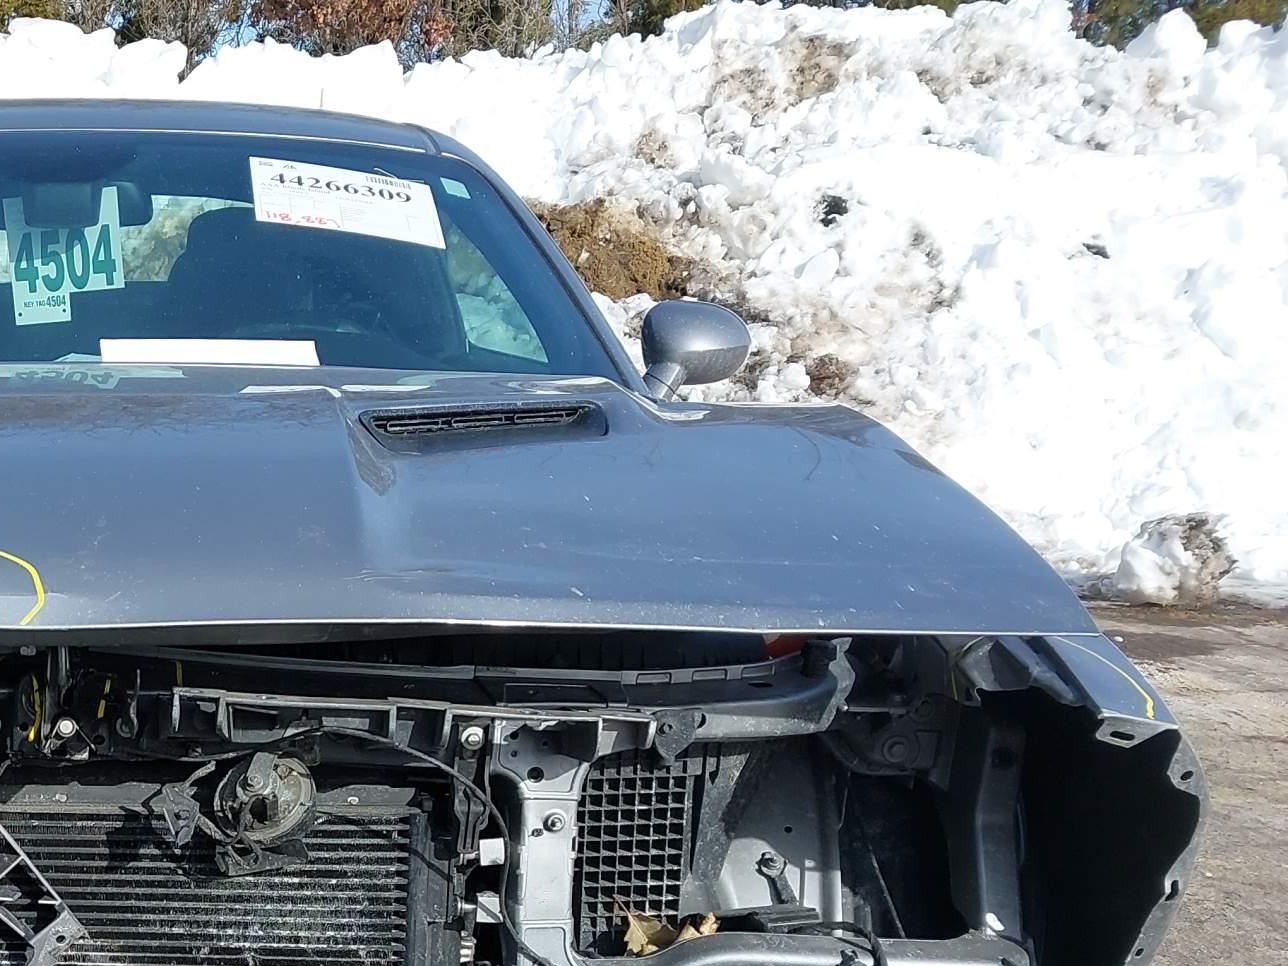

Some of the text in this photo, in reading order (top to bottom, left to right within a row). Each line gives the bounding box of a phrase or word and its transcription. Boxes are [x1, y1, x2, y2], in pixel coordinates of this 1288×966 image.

[270, 173, 411, 202] 44266309
[14, 224, 117, 293] 4504
[46, 295, 66, 307] 4504
